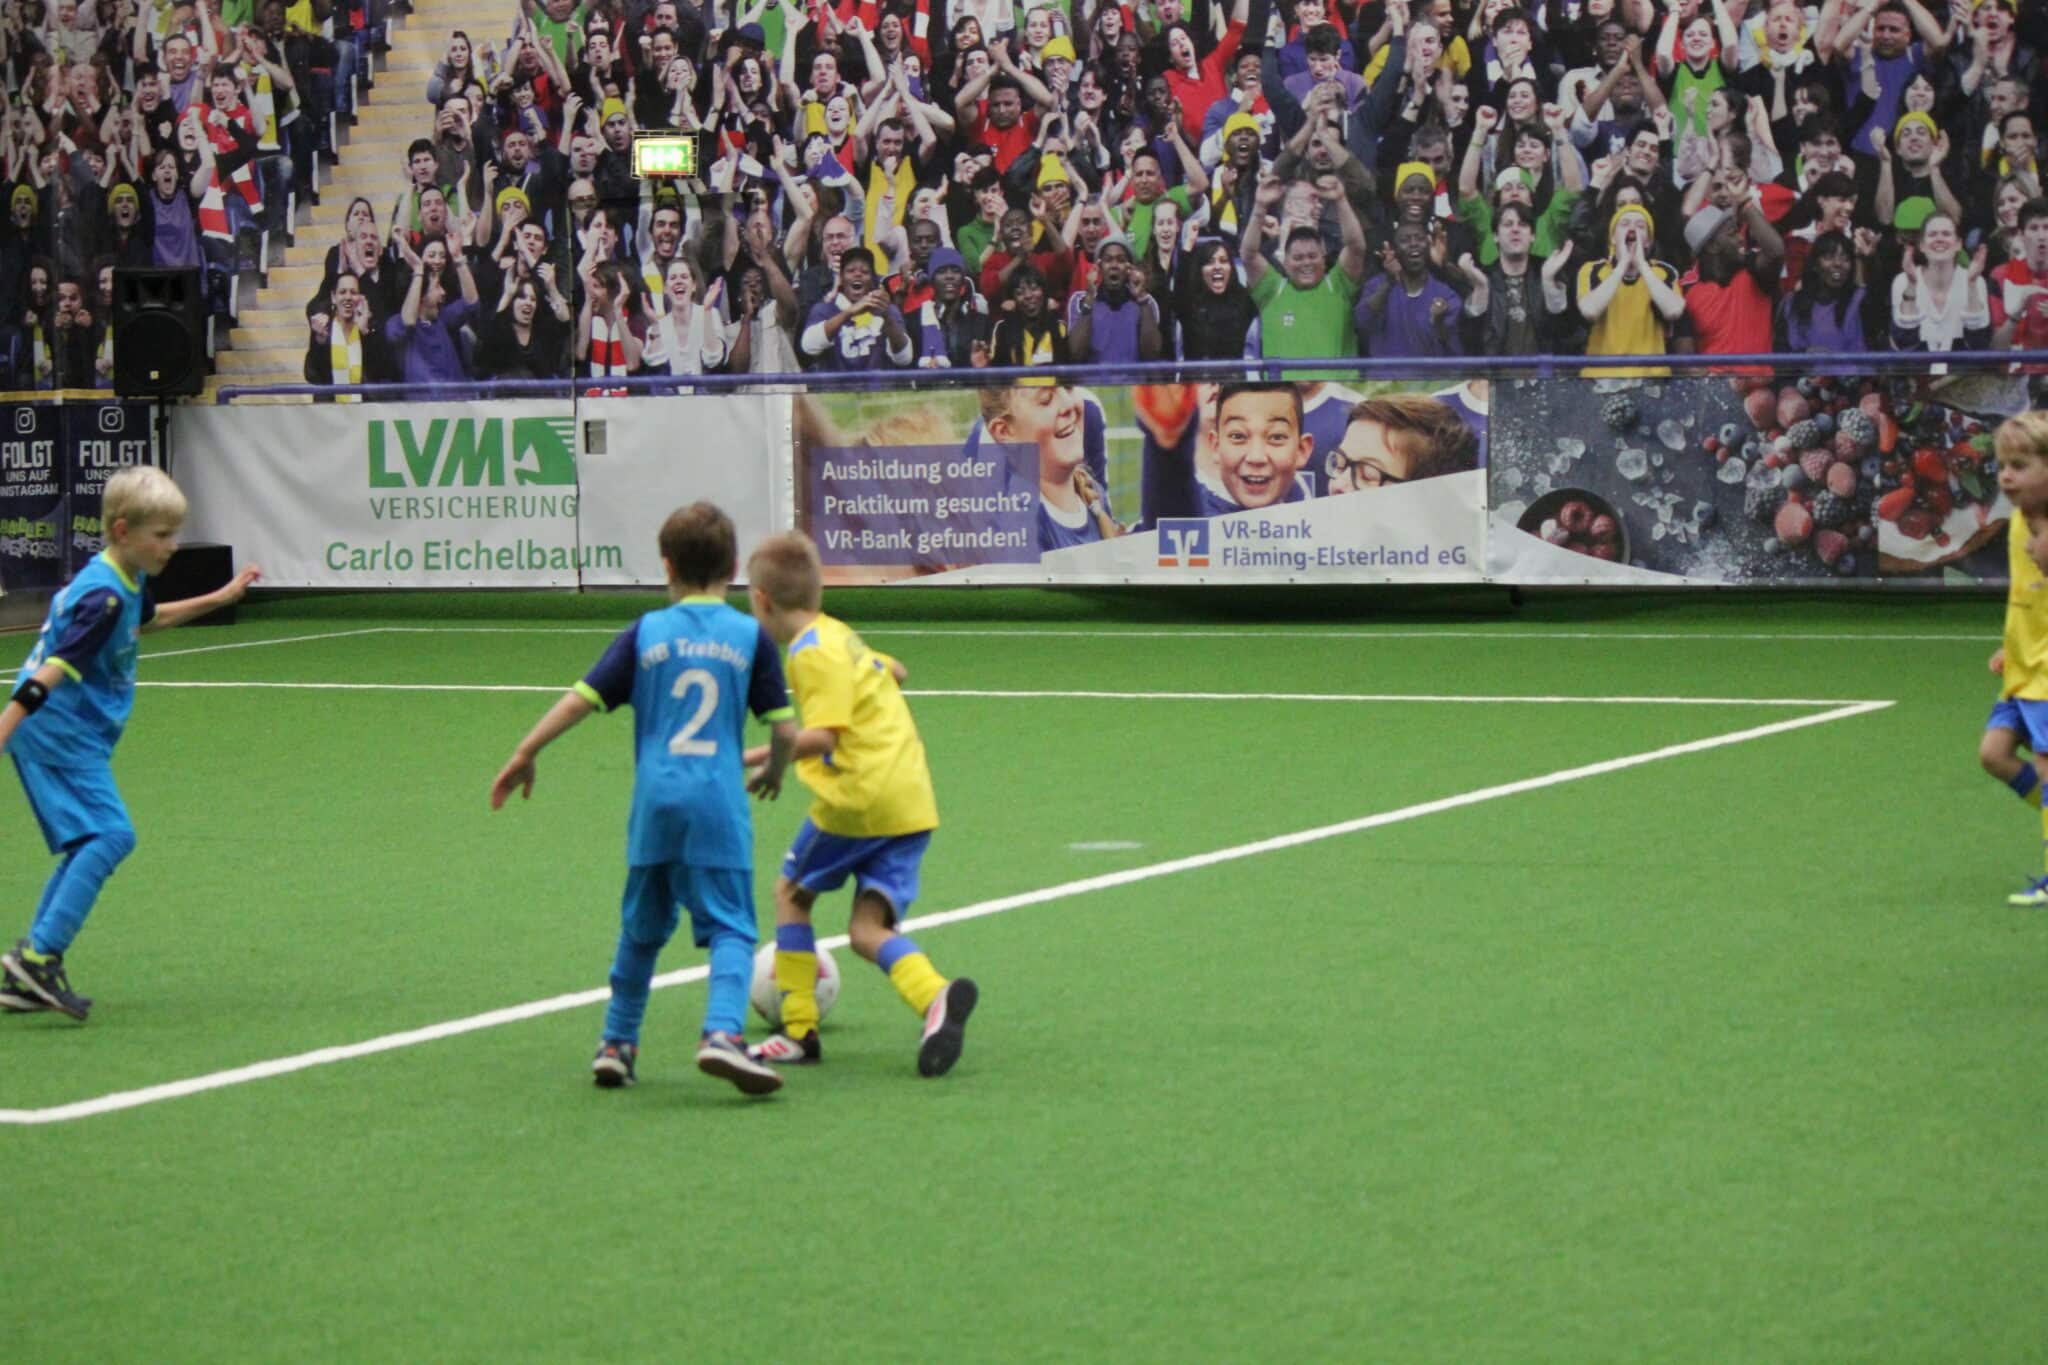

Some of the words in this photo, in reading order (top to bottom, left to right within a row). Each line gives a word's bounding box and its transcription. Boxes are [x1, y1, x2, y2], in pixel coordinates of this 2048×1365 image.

[2, 440, 54, 469] FOLGT
[79, 439, 147, 468] FOLGT
[368, 417, 505, 488] LVM
[6, 470, 26, 483] UNS
[28, 469, 50, 481] AUF
[84, 469, 110, 481] UNS
[822, 459, 942, 484] Ausbildung
[946, 457, 996, 478] oder
[369, 495, 578, 520] VERSICHERUNG
[824, 495, 929, 514] Praktikum
[935, 492, 1032, 518] gesucht?
[824, 529, 912, 549] VR-Bank
[917, 528, 1027, 554] gefunden!
[1222, 519, 1313, 540] VR-Bank
[326, 540, 414, 571] Carlo
[423, 539, 623, 571] Eichelbaum
[1222, 545, 1429, 571] Fläming-Elsterland
[1438, 545, 1467, 566] eG
[668, 668, 719, 757] 2
